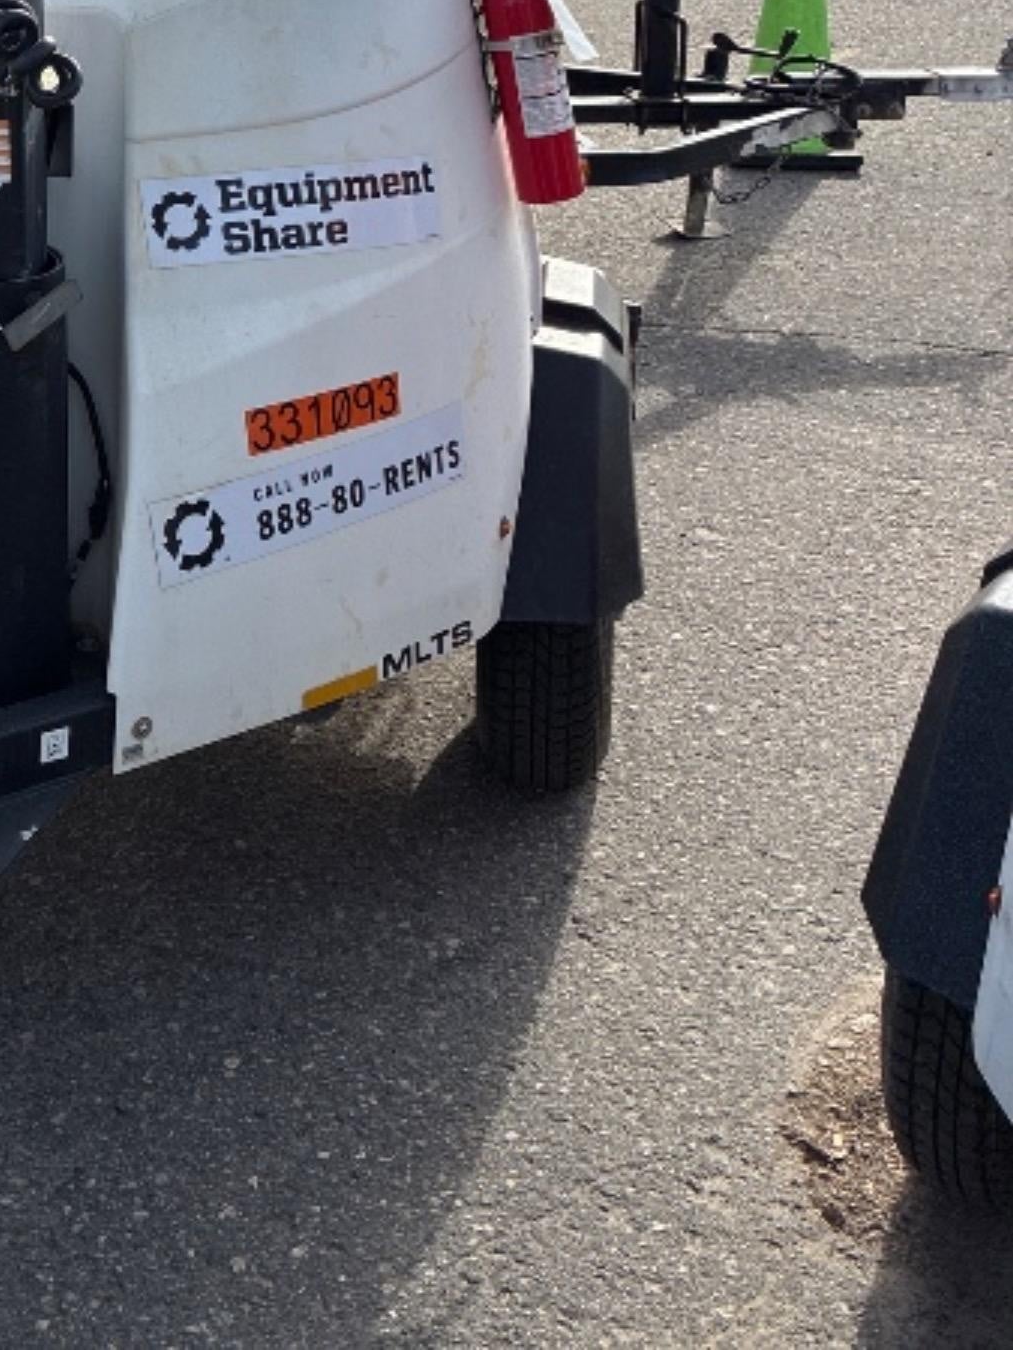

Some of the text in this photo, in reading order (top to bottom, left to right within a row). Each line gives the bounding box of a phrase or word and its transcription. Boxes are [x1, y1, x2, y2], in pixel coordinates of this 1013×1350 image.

[214, 161, 436, 216] Equipment
[220, 218, 349, 255] Share
[250, 374, 399, 452] 331093
[253, 478, 292, 502] CALL
[256, 440, 461, 541] 888-80-RENTS
[383, 620, 473, 679] MLTS
